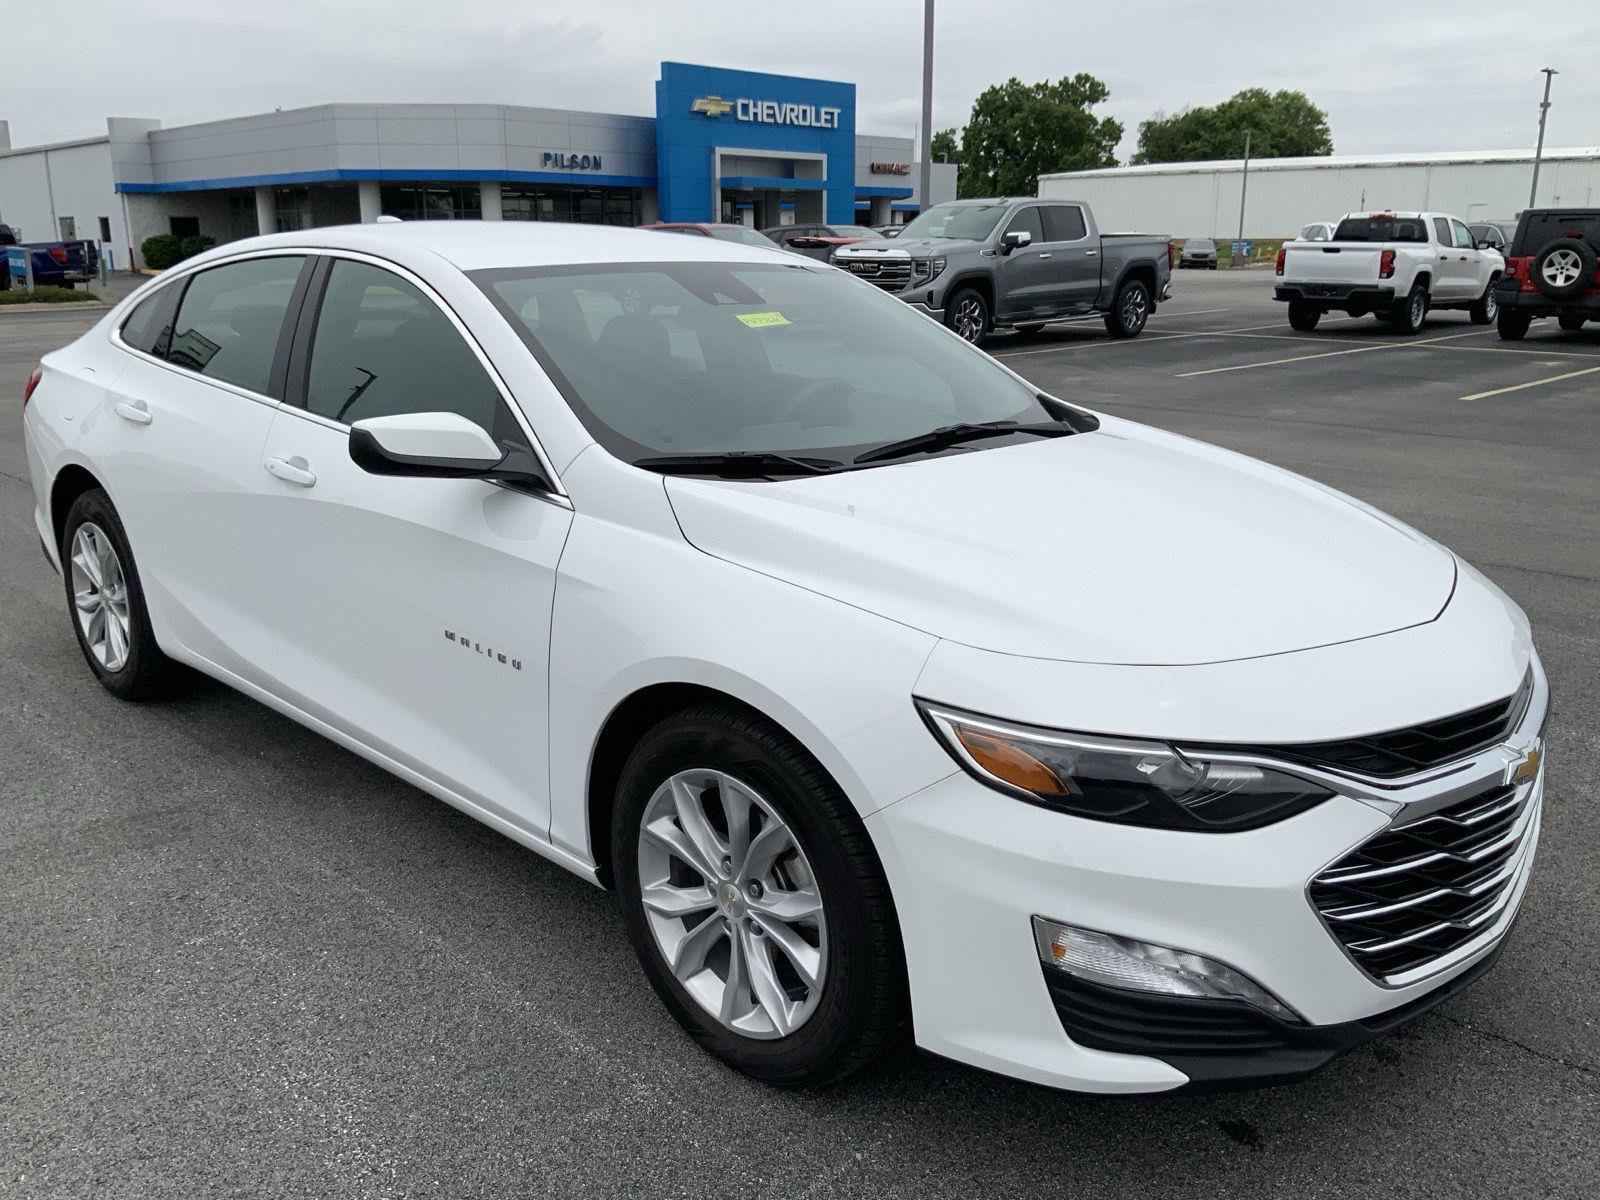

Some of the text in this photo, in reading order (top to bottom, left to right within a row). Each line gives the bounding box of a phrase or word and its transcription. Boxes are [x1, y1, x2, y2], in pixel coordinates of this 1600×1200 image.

[736, 98, 842, 129] CHEVROLET
[542, 152, 602, 170] PILSON
[444, 629, 522, 671] MALIBU
